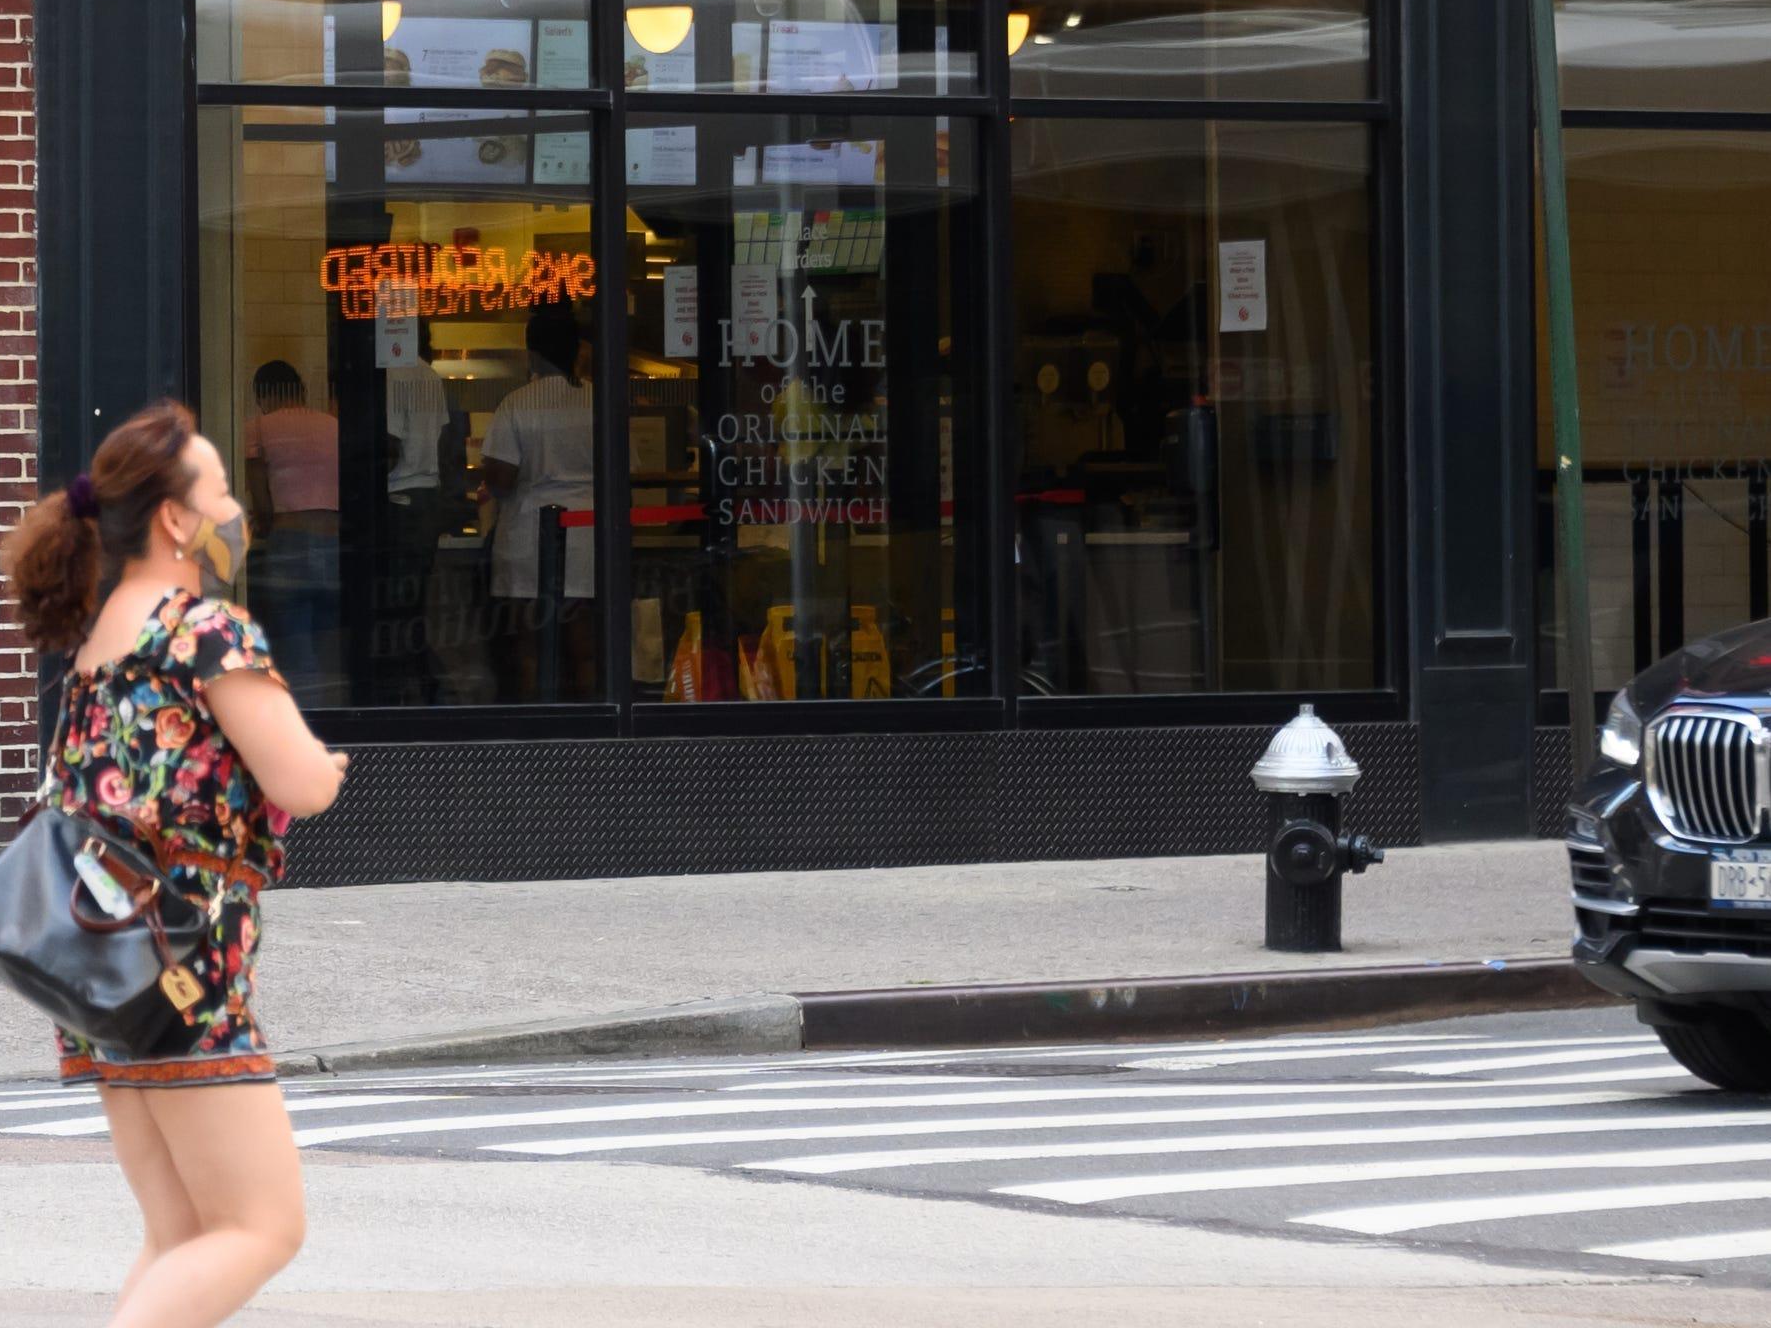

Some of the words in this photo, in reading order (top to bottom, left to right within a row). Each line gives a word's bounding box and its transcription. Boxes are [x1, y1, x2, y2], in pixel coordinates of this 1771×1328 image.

[717, 319, 887, 368] HOME
[761, 376, 789, 404] of
[799, 376, 845, 404] the
[717, 414, 887, 444] ORIGINAL
[718, 456, 887, 486] CHICKEN
[718, 498, 888, 525] SANDWICH
